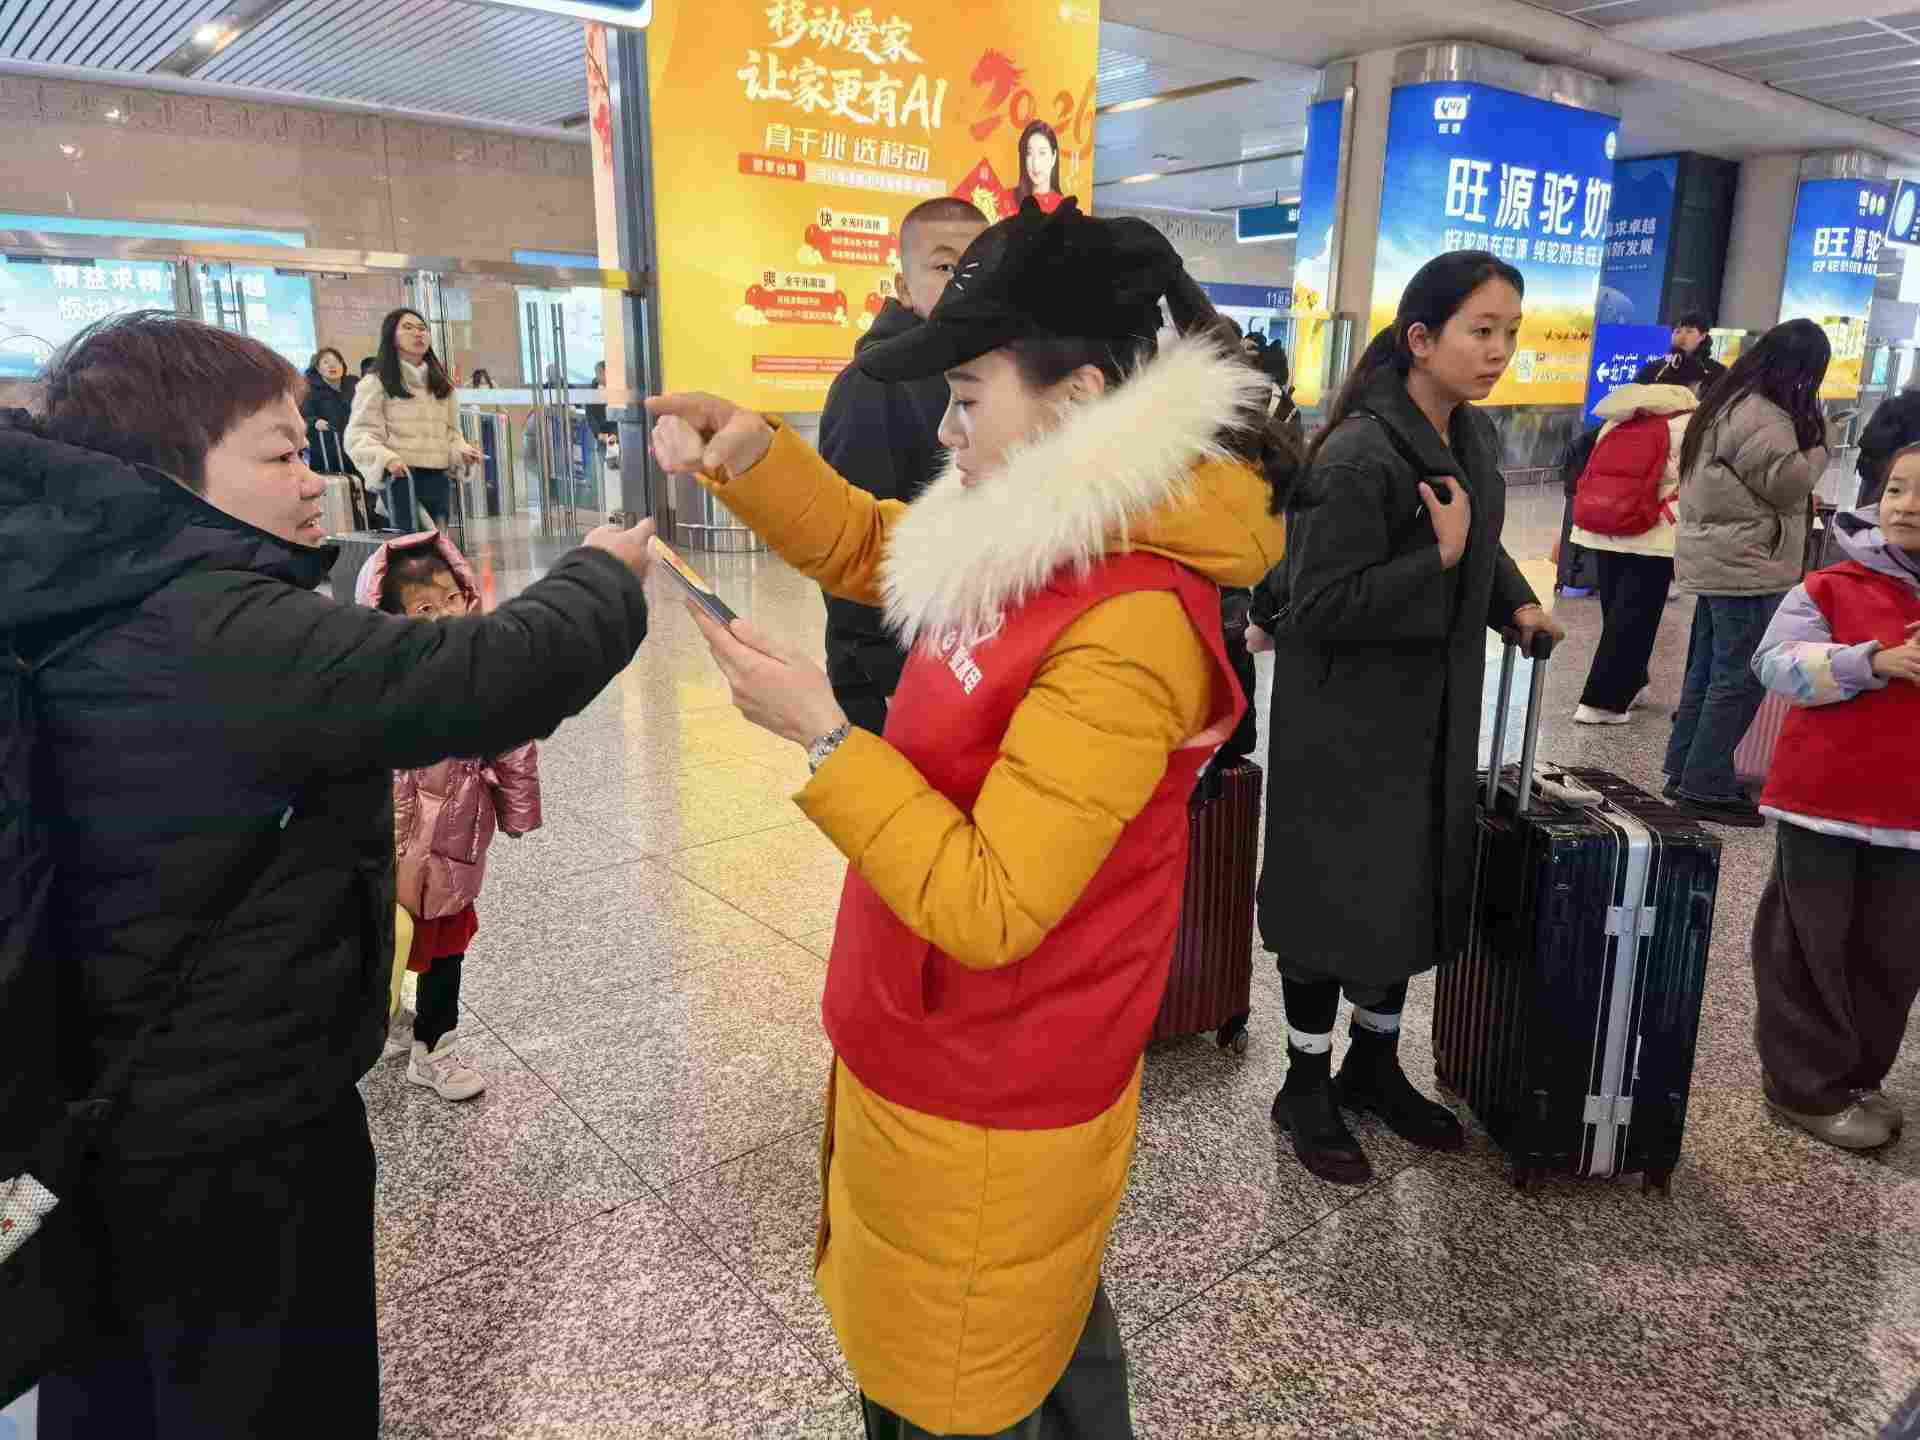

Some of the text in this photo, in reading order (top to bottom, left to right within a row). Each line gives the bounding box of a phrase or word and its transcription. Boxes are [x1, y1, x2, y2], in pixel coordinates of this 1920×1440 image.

[765, 0, 925, 65] 移动爱家
[736, 49, 948, 130] 让家更有AI
